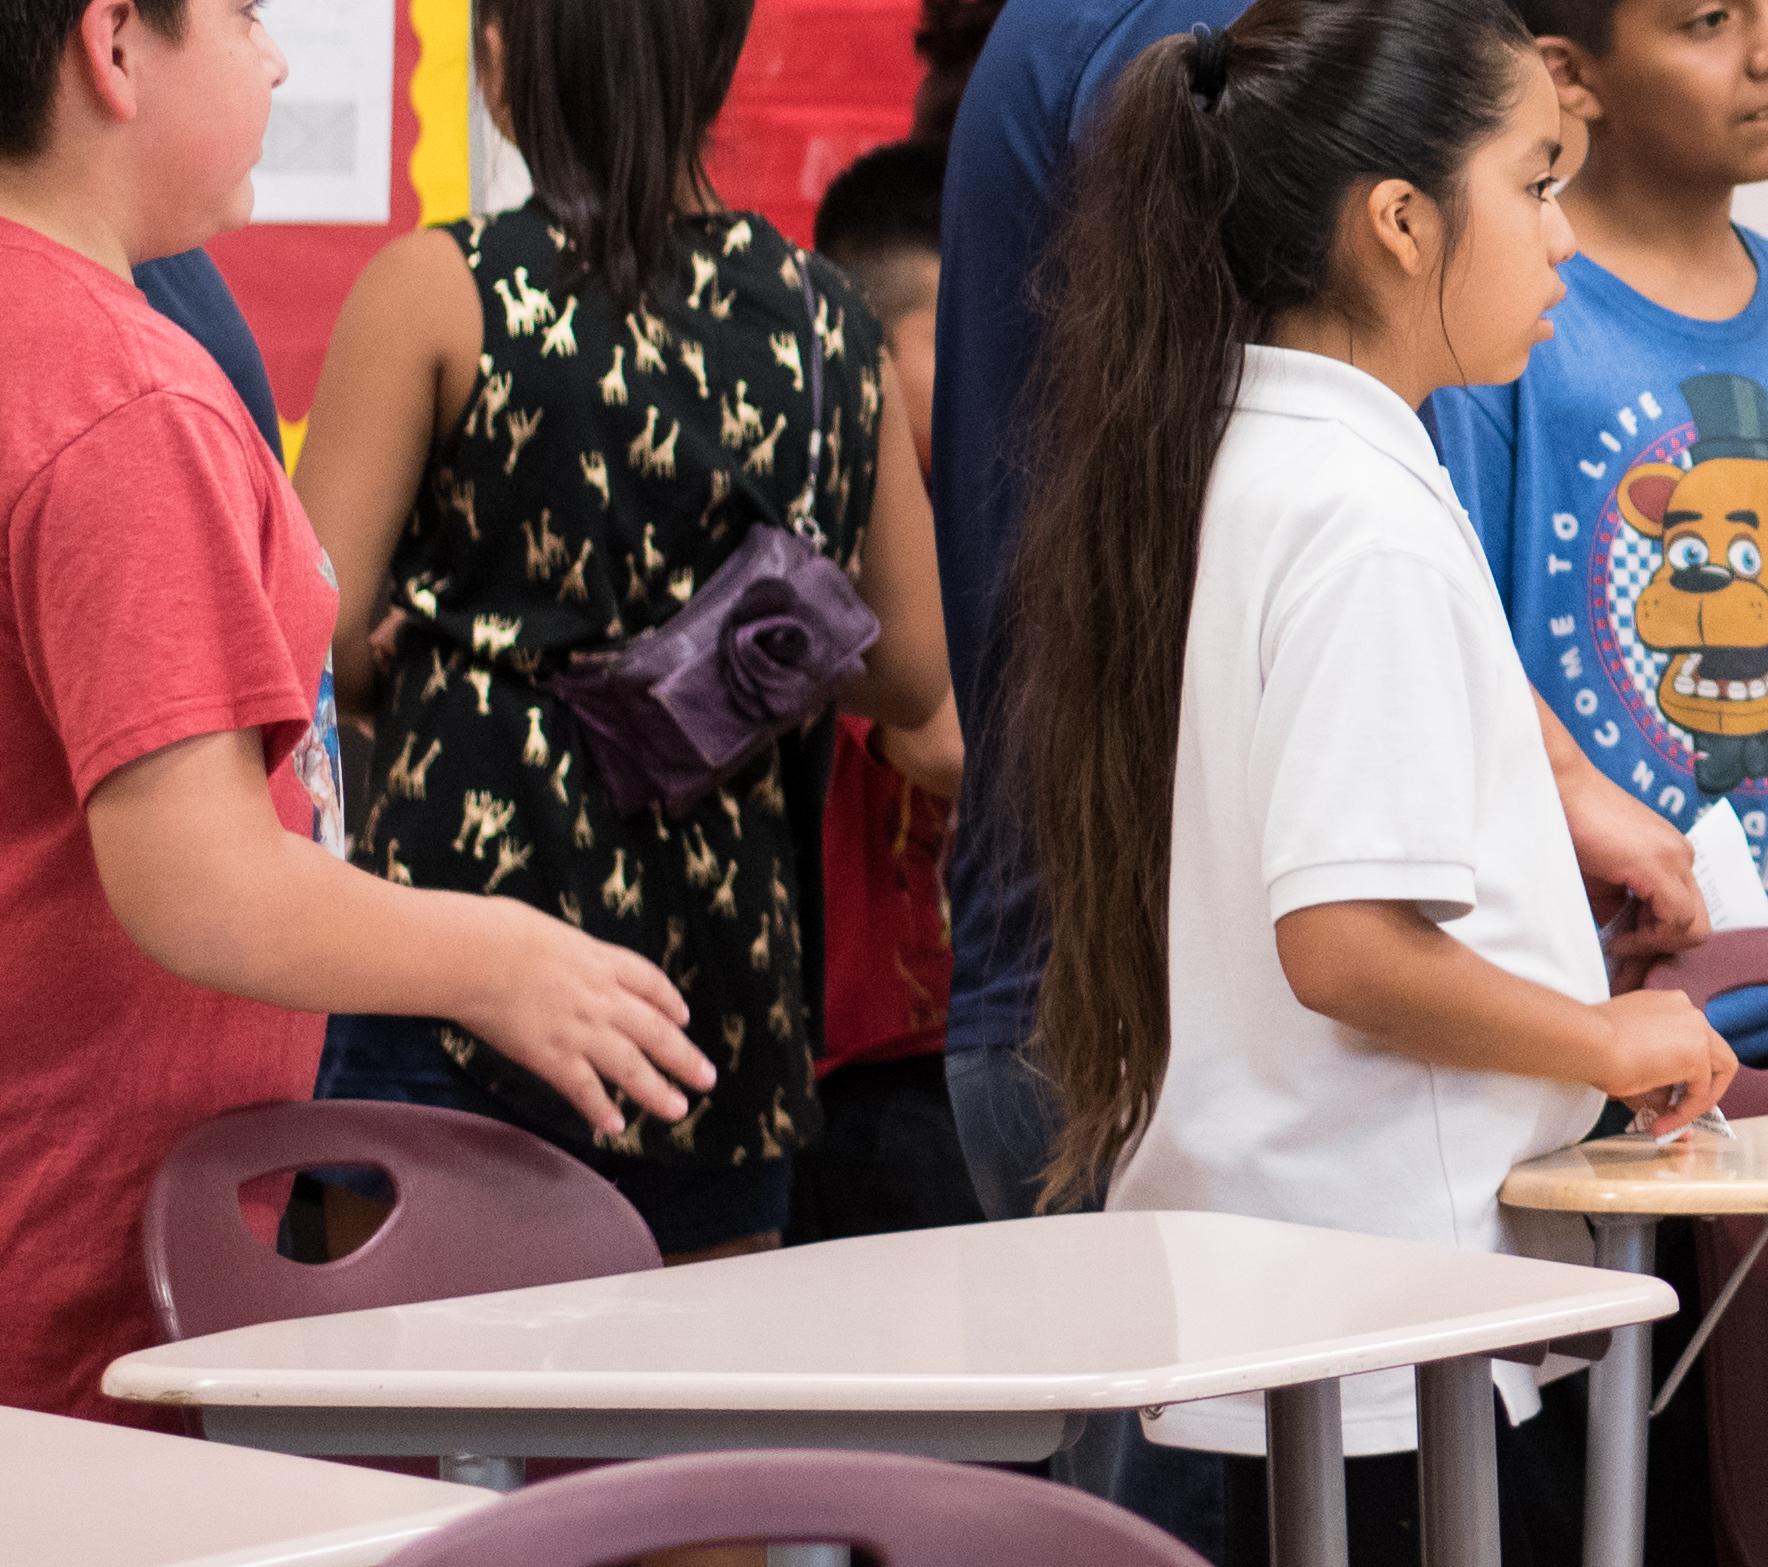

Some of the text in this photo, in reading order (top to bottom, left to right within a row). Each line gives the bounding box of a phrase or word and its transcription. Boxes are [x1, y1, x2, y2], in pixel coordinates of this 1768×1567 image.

[1578, 390, 1663, 480] LIFE
[1548, 512, 1580, 575] TO
[1551, 614, 1620, 749] COME
